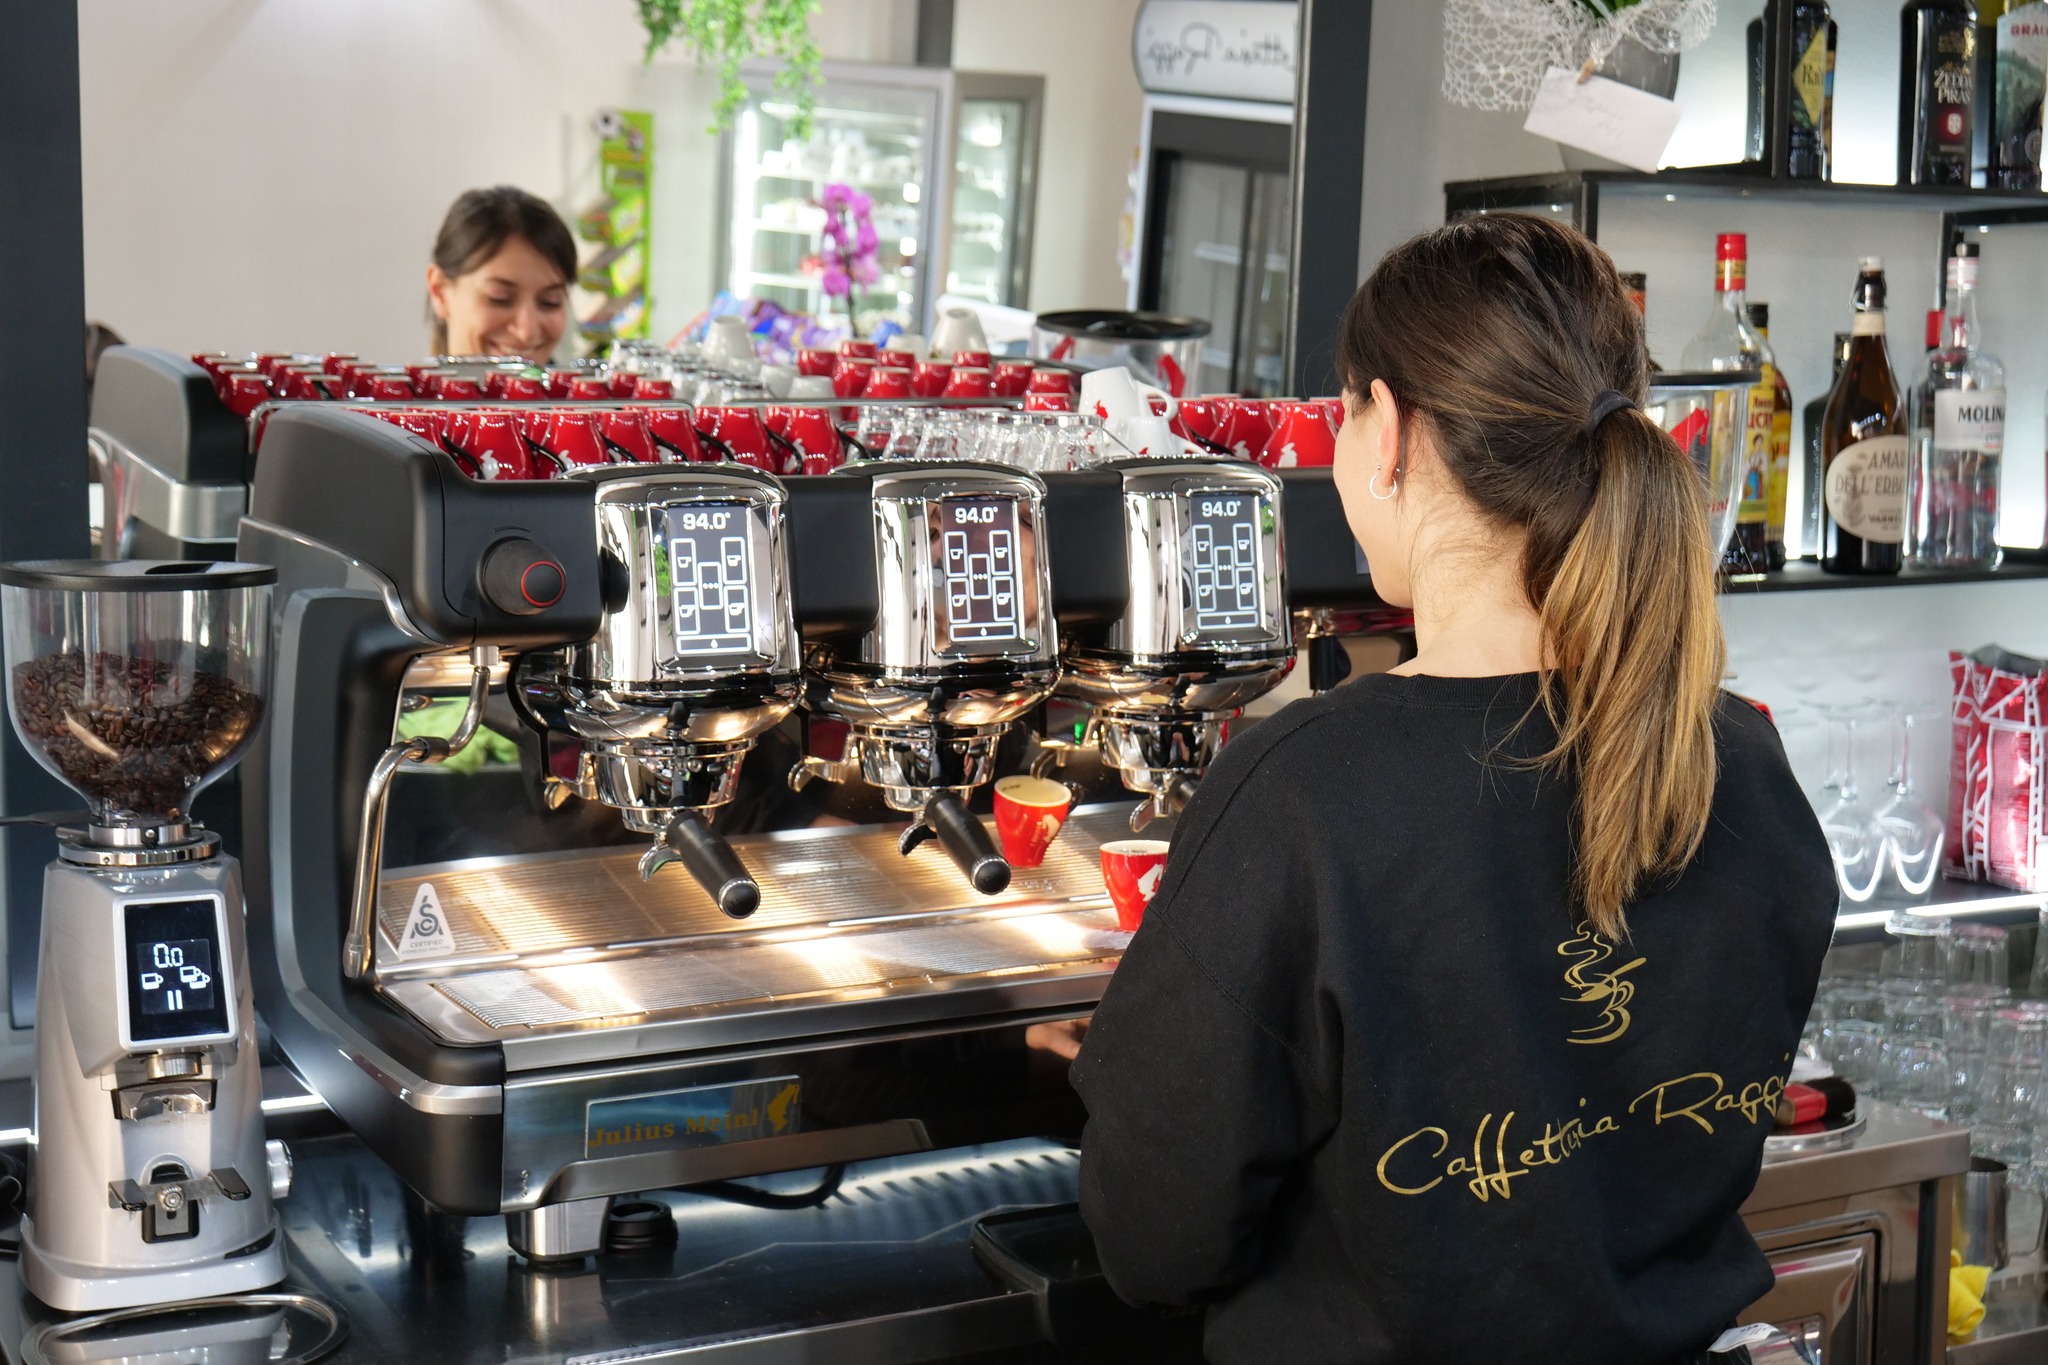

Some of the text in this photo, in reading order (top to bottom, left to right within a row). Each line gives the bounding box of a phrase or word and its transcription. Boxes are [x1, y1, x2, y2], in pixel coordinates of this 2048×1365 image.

[955, 506, 998, 524] 94.0°
[1202, 501, 1241, 518] 94.0°
[683, 512, 731, 530] 94.0°
[153, 943, 184, 968] 0.0
[588, 1109, 759, 1148] Julius Meinl
